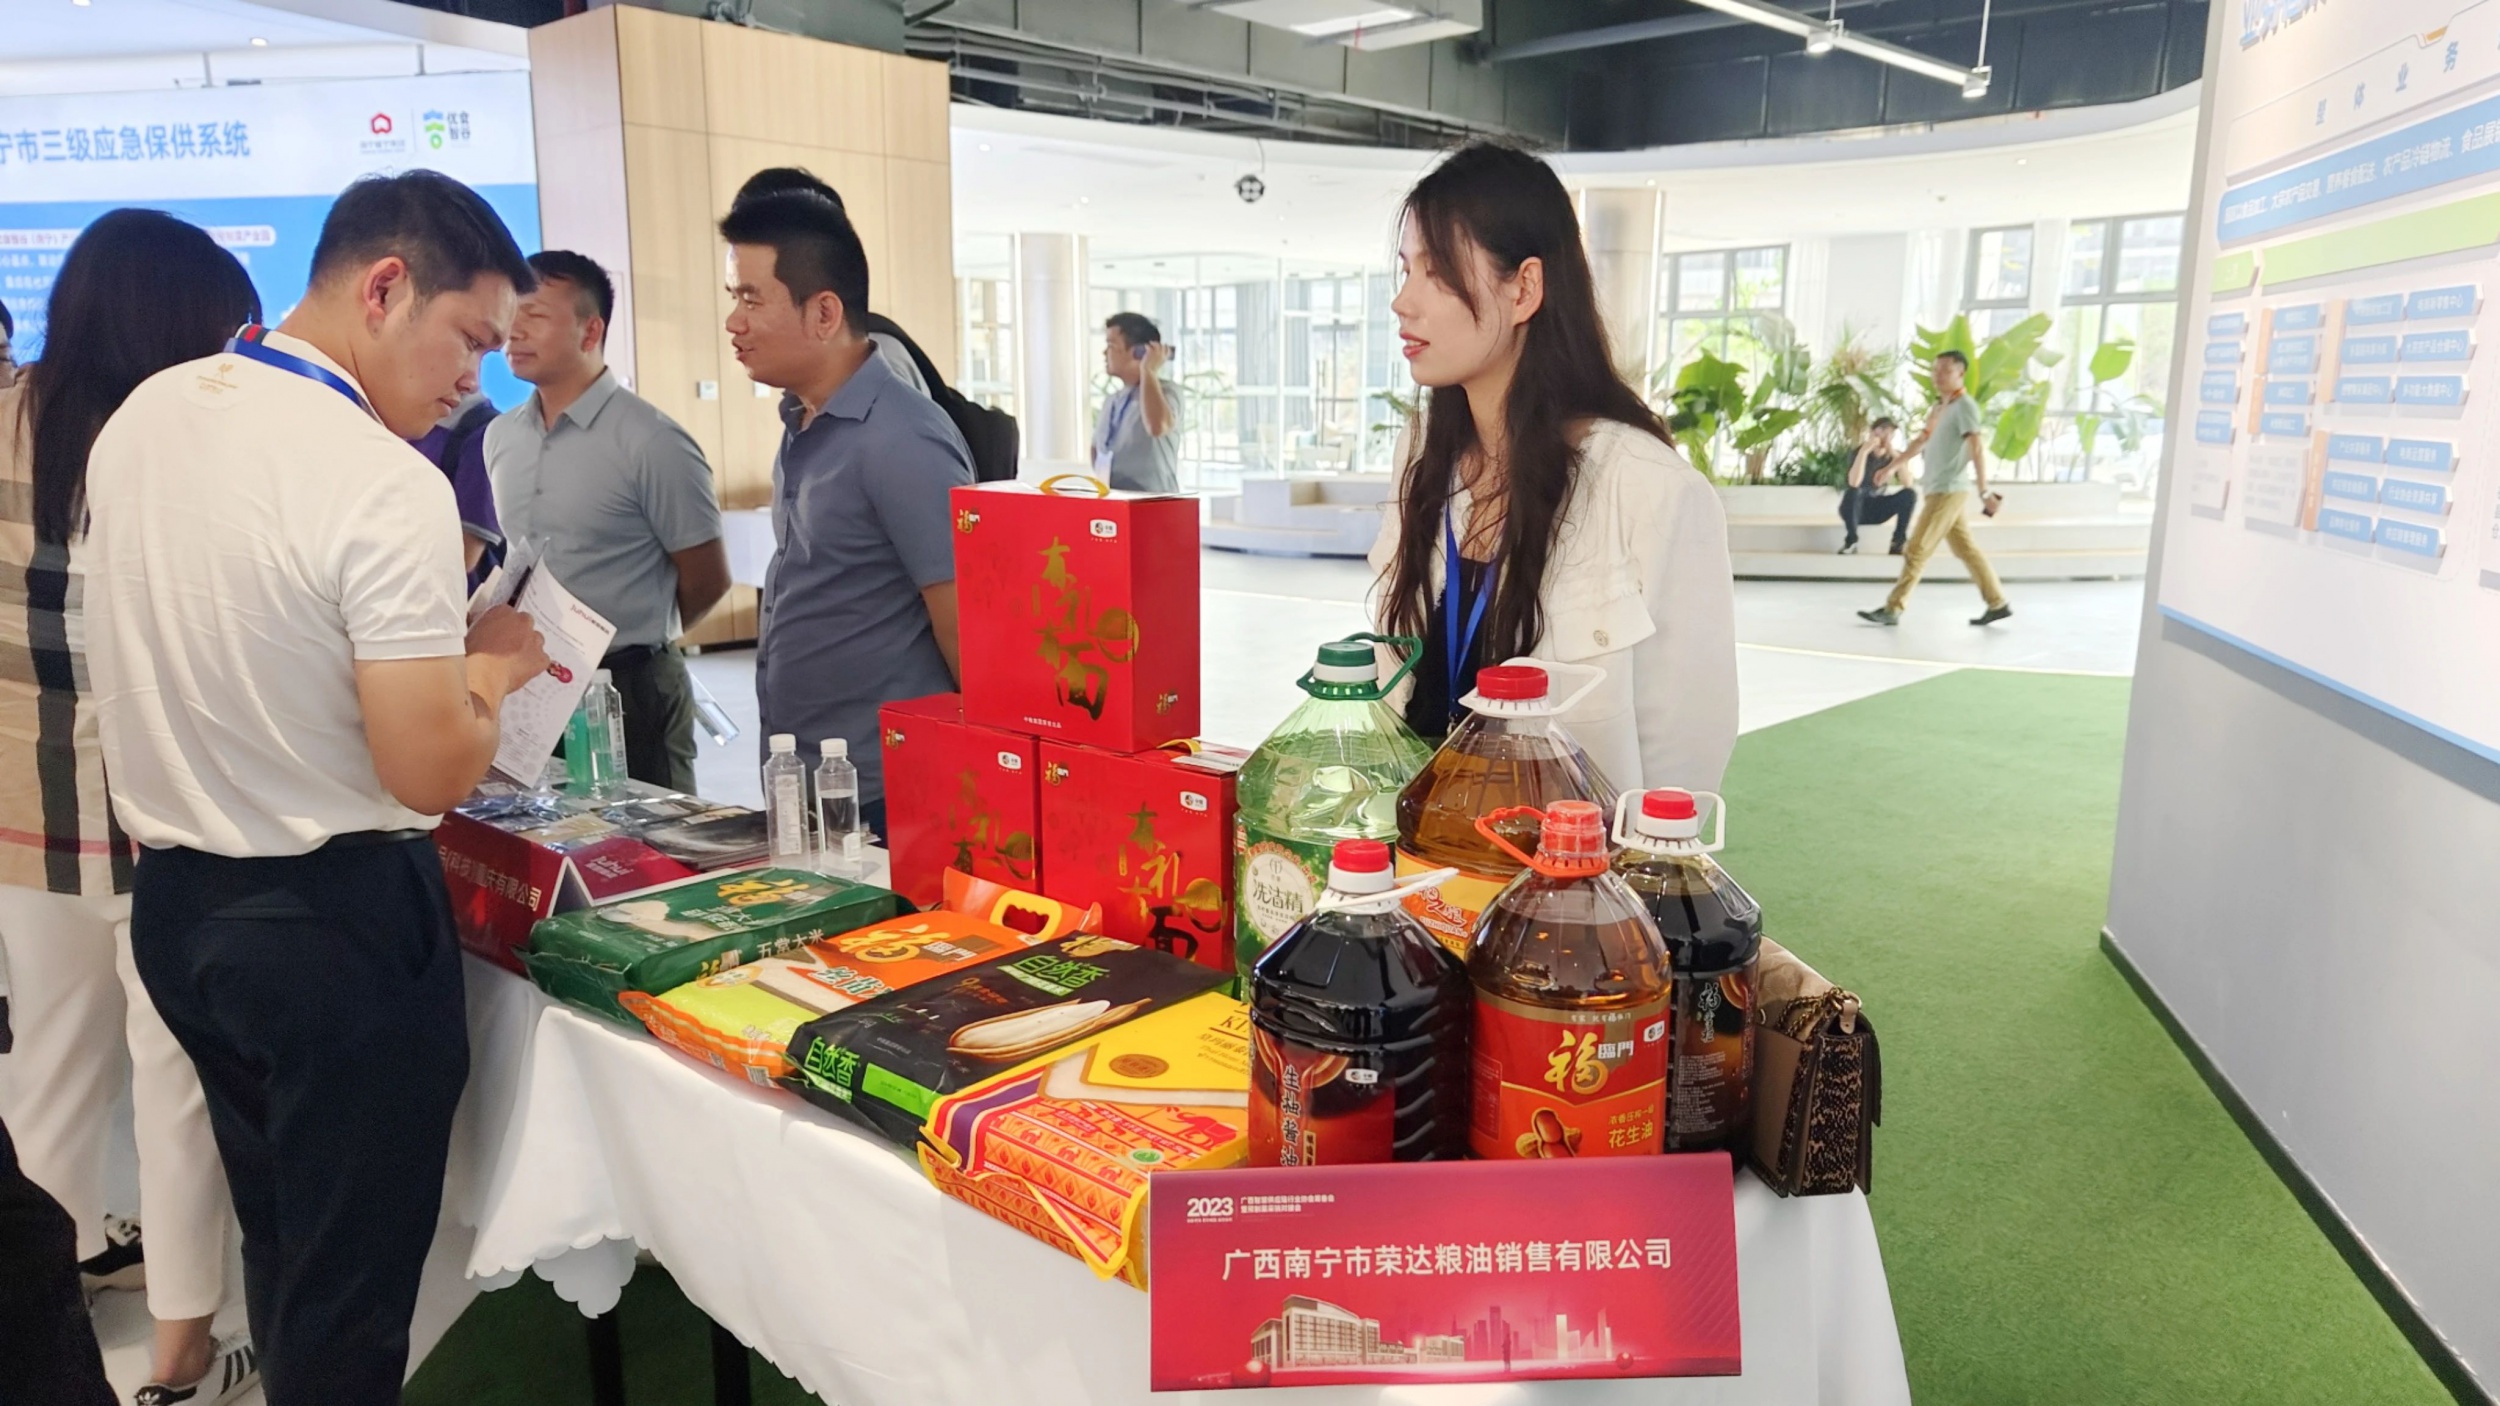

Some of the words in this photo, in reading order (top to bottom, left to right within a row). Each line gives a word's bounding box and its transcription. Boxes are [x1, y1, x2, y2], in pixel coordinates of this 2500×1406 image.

[0, 120, 251, 165] 宁市三级应急保供系统
[1247, 879, 1303, 914] 洗洁精
[757, 929, 825, 957] 五常大米
[804, 1036, 860, 1087] 自然香
[1280, 1064, 1300, 1167] 生抽酱油
[1609, 1119, 1654, 1149] 花生油
[1187, 1198, 1234, 1217] 2023
[1222, 1237, 1673, 1281] 广西南宁市荣达粮油销售有限公司
